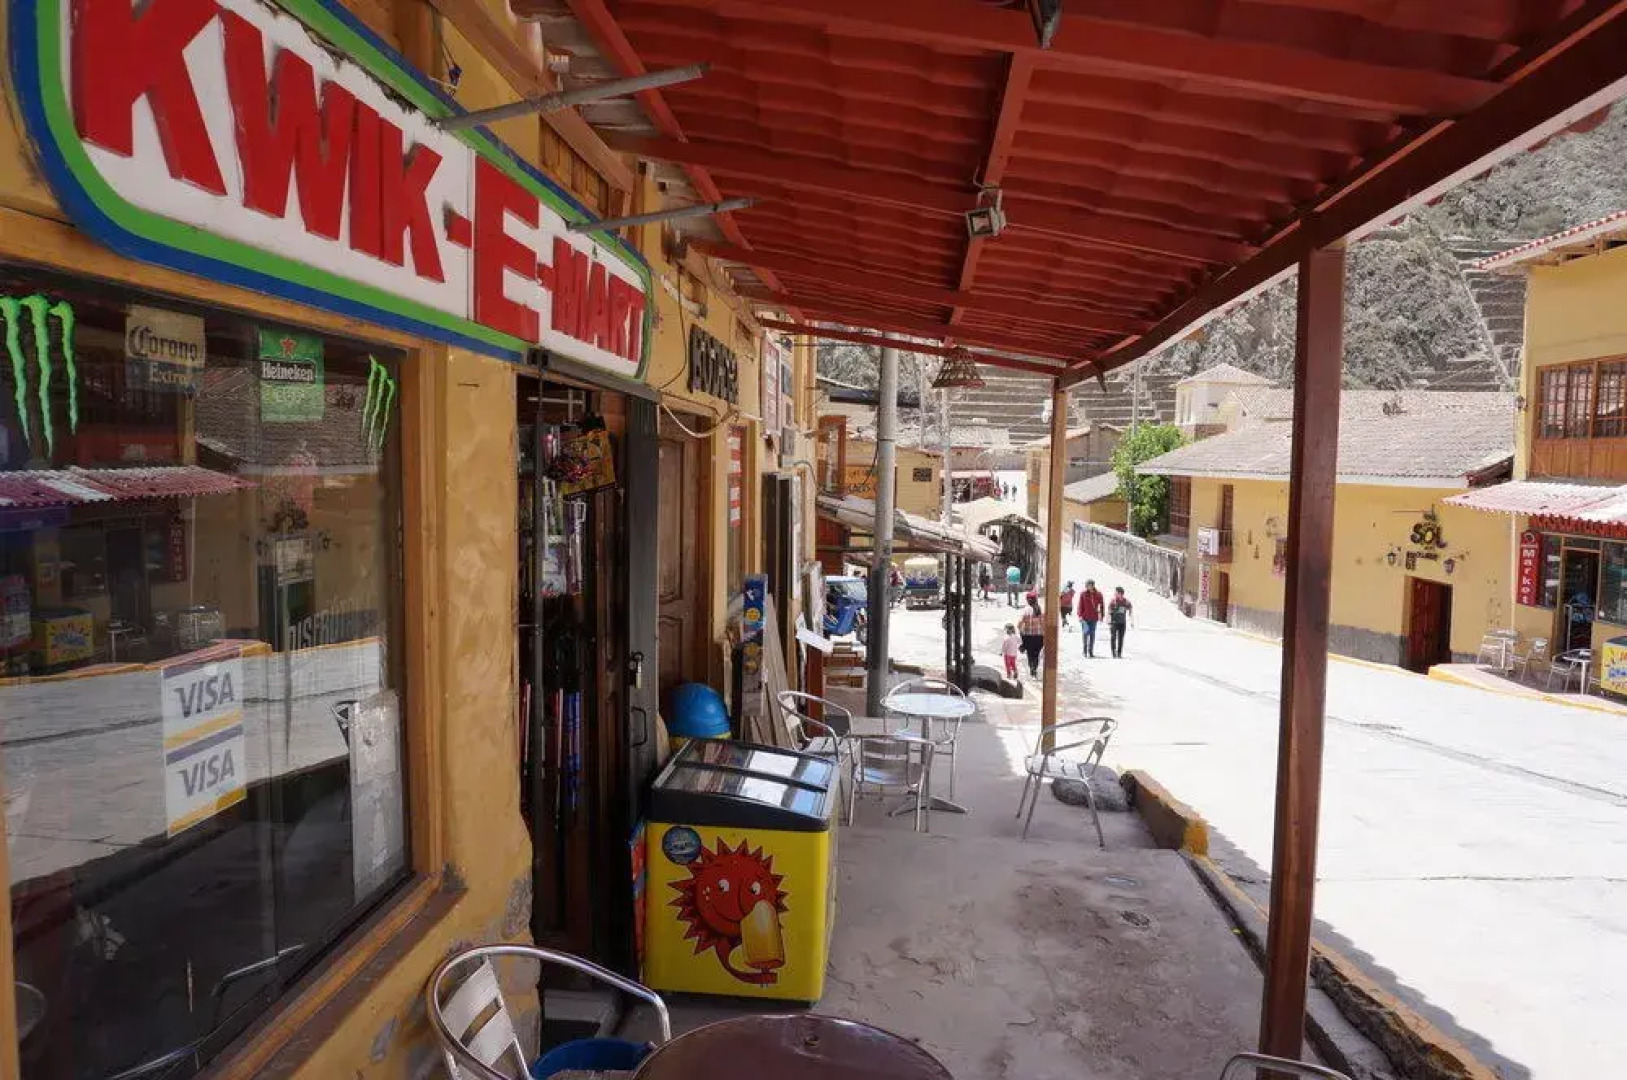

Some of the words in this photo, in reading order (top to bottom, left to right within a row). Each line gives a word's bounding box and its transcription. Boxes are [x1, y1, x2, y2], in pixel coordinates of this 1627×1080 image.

[128, 325, 198, 361] Corona
[261, 361, 314, 382] Heineken
[174, 671, 235, 718] VISA
[178, 749, 236, 798] VISA
